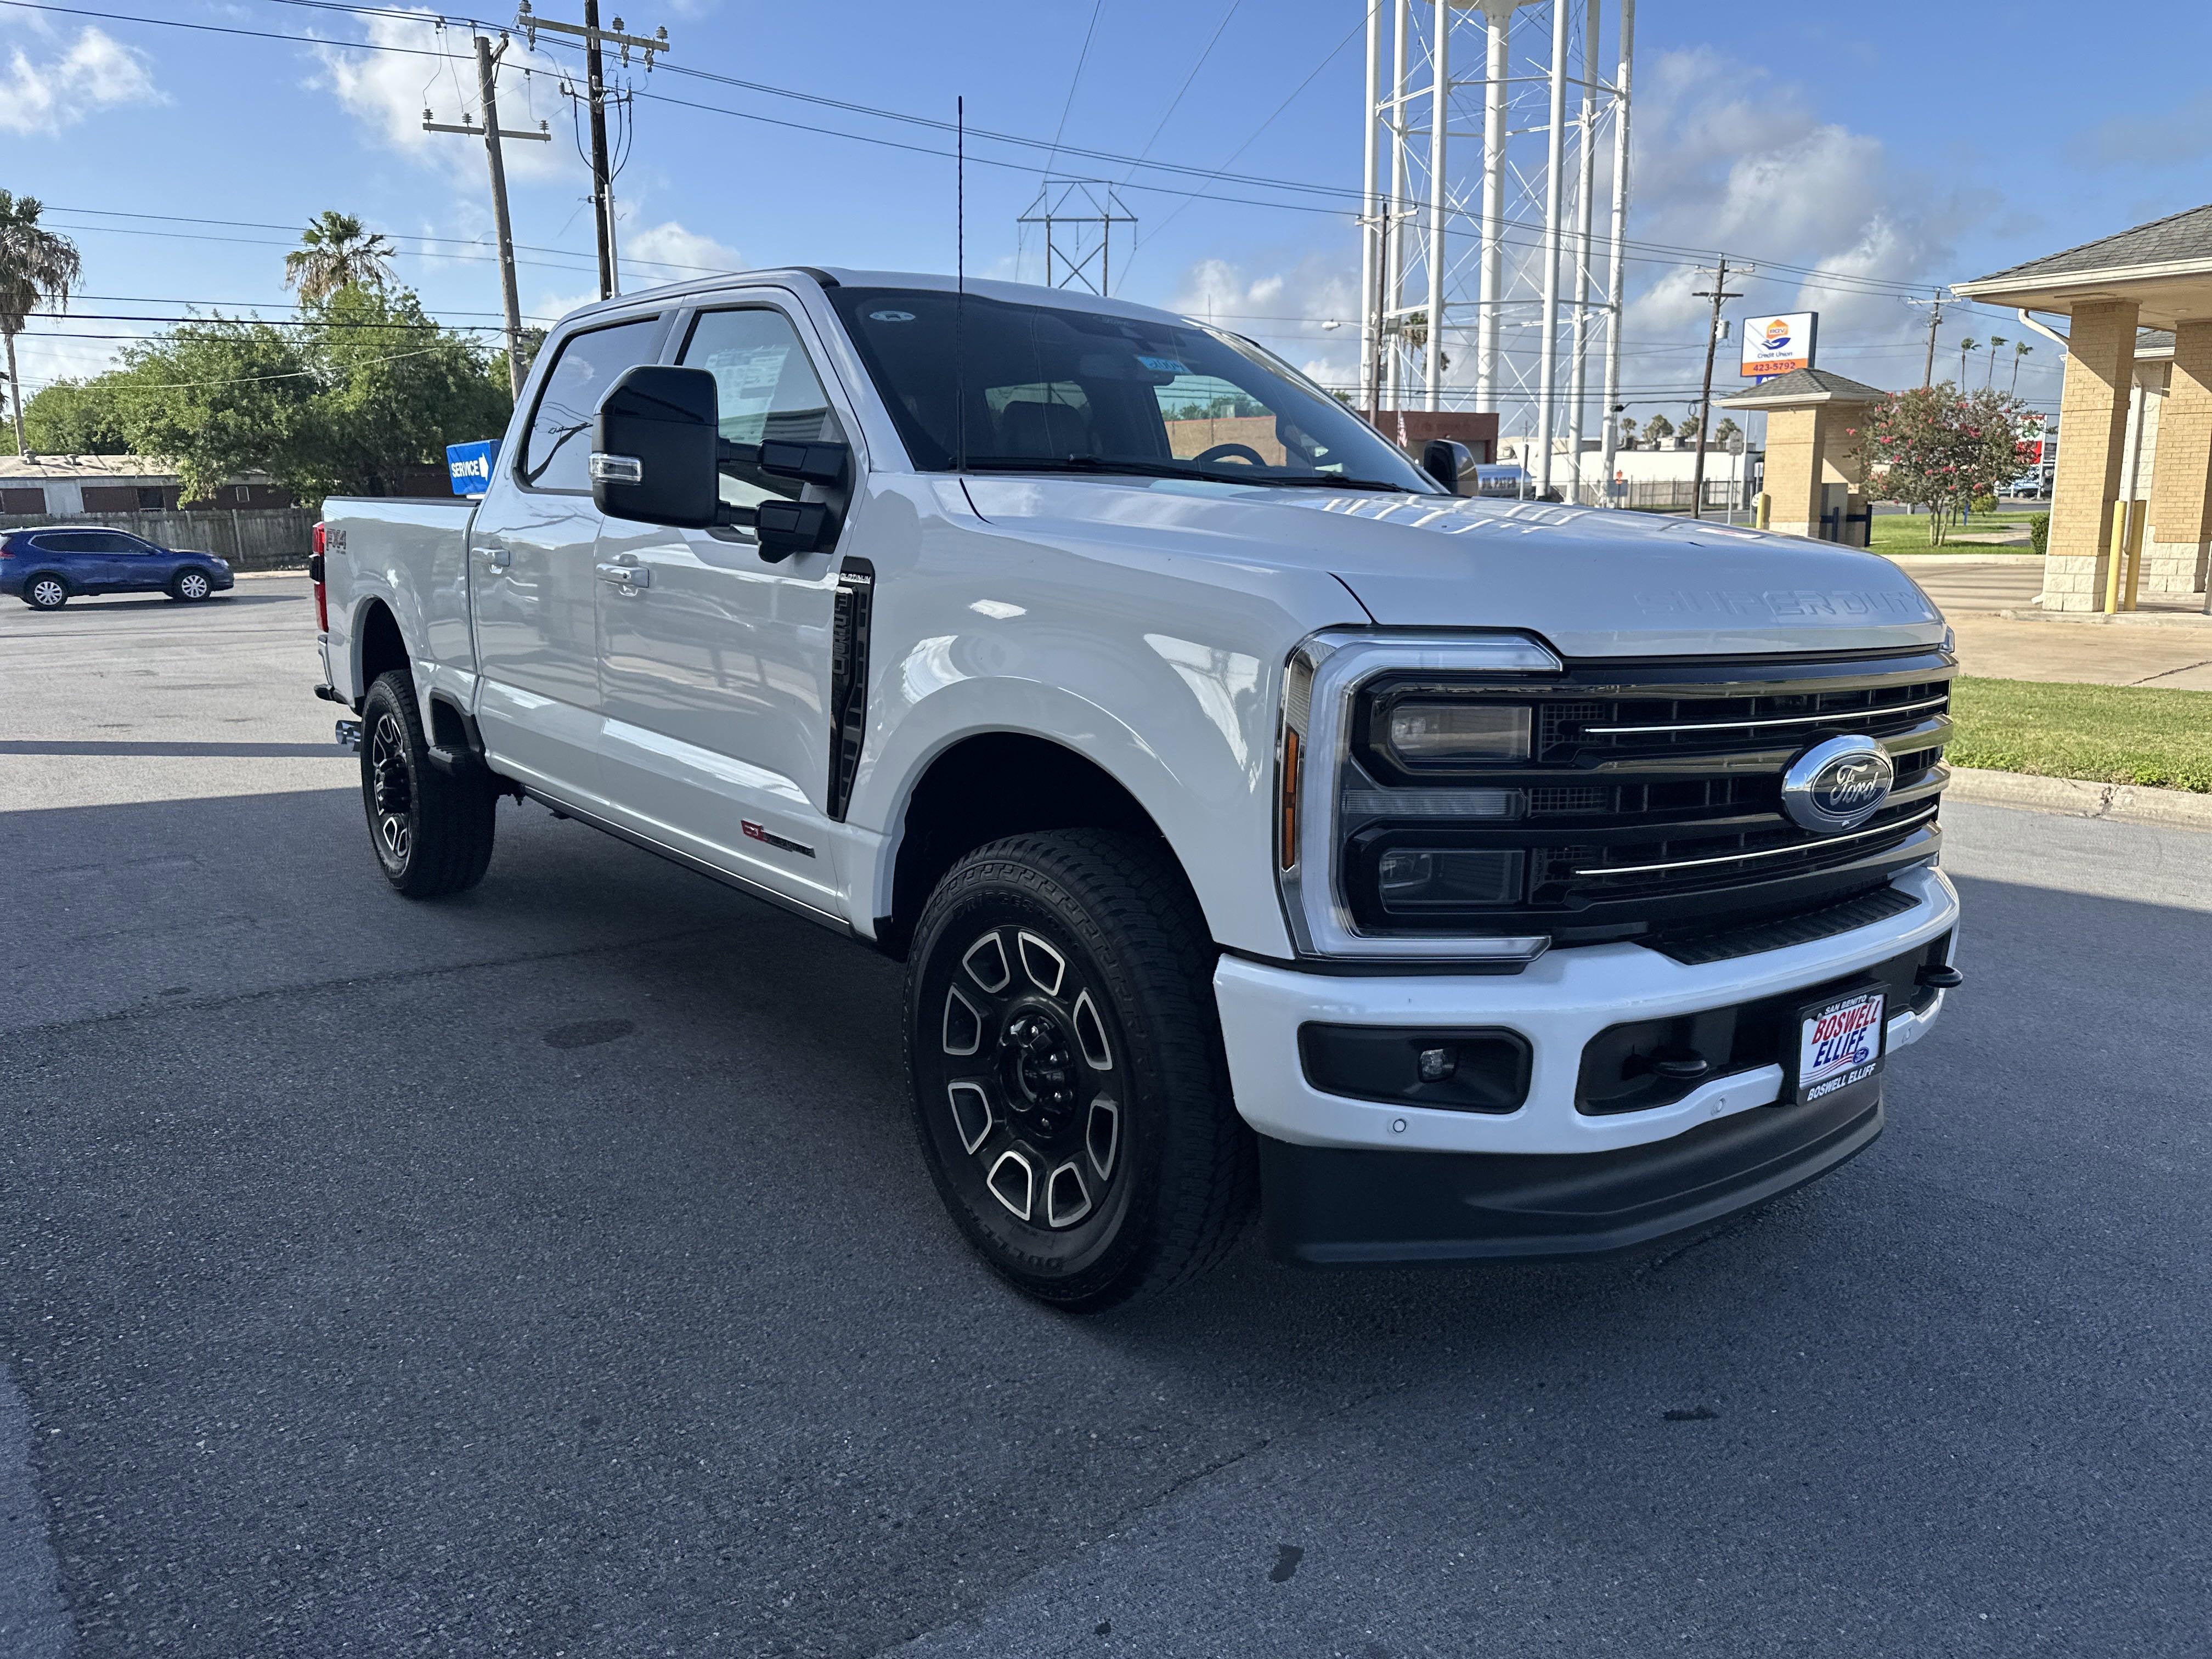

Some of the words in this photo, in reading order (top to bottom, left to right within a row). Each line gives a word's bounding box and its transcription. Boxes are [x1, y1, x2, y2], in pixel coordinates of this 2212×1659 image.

[1753, 362, 1796, 371] 423-5792
[451, 460, 479, 478] SERVICE
[326, 528, 347, 551] FX4
[840, 573, 871, 584] PLATINUM
[1830, 764, 1879, 806] Ford
[1825, 1002, 1841, 1015] SAN
[1840, 994, 1867, 1009] BENITO
[1812, 1000, 1880, 1045] BOSWELL
[1813, 1027, 1867, 1068] ELLIFF
[1807, 1075, 1847, 1102] BOSWELL
[1847, 1063, 1876, 1085] ELLIFF
